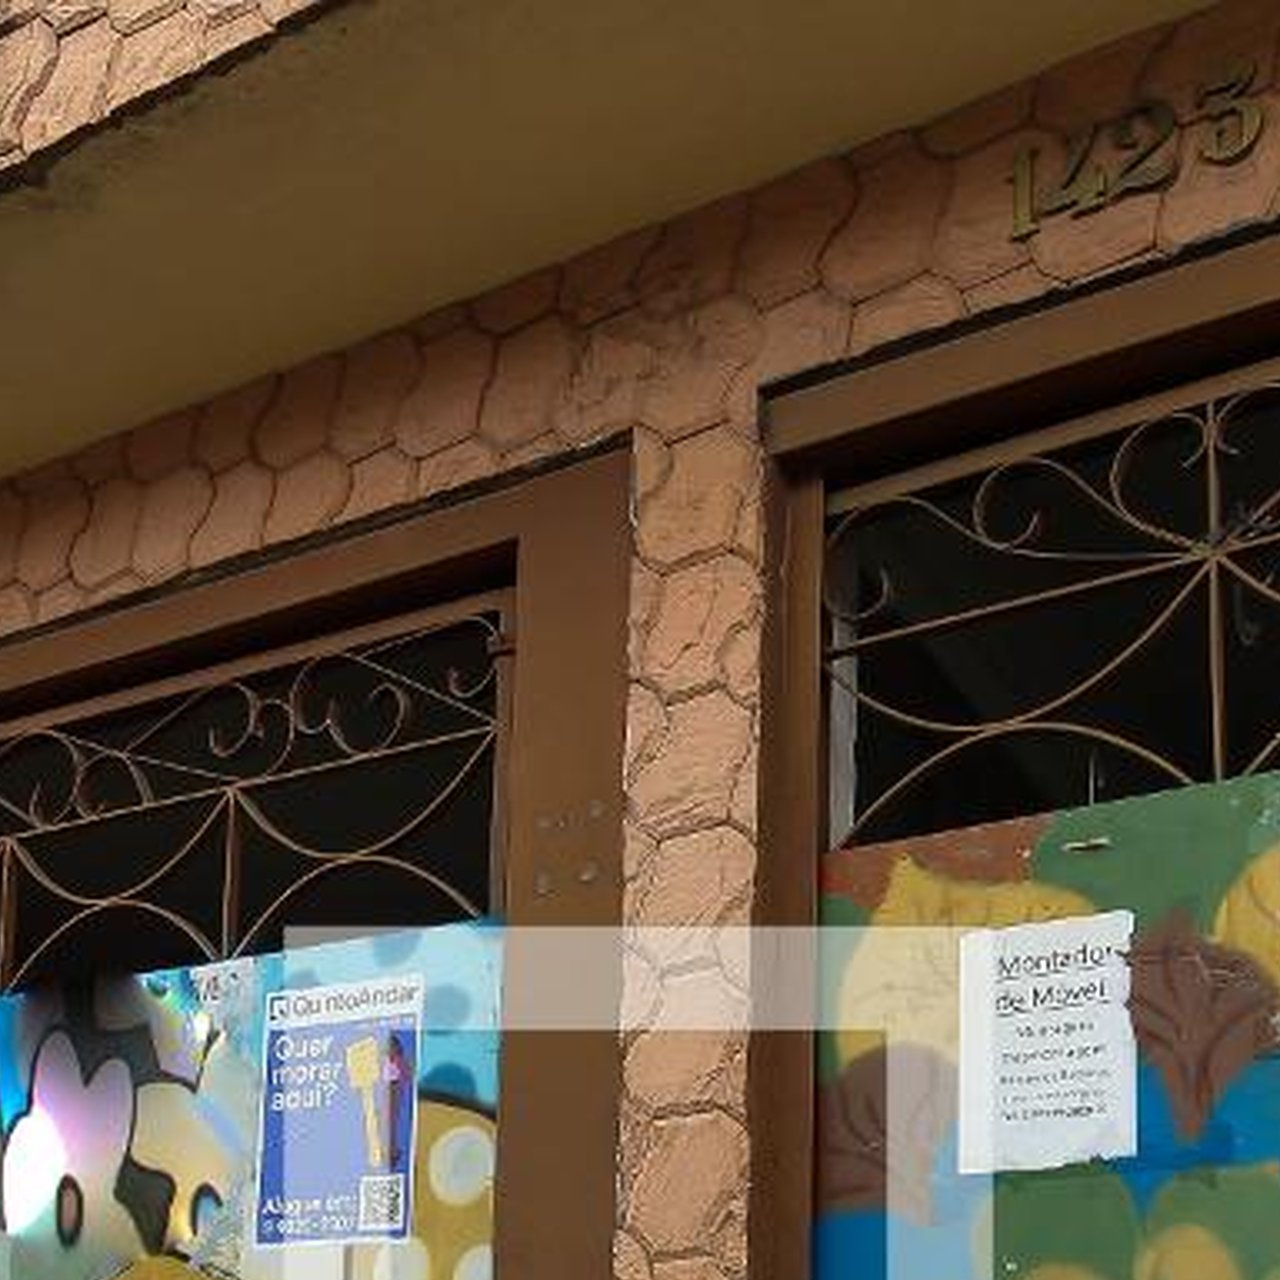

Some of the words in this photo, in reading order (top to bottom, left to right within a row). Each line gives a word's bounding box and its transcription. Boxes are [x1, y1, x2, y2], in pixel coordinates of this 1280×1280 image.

[1010, 56, 1265, 242] 1425
[275, 1034, 334, 1061] Quer
[272, 1062, 343, 1086] morar
[271, 1081, 339, 1112] aqui?
